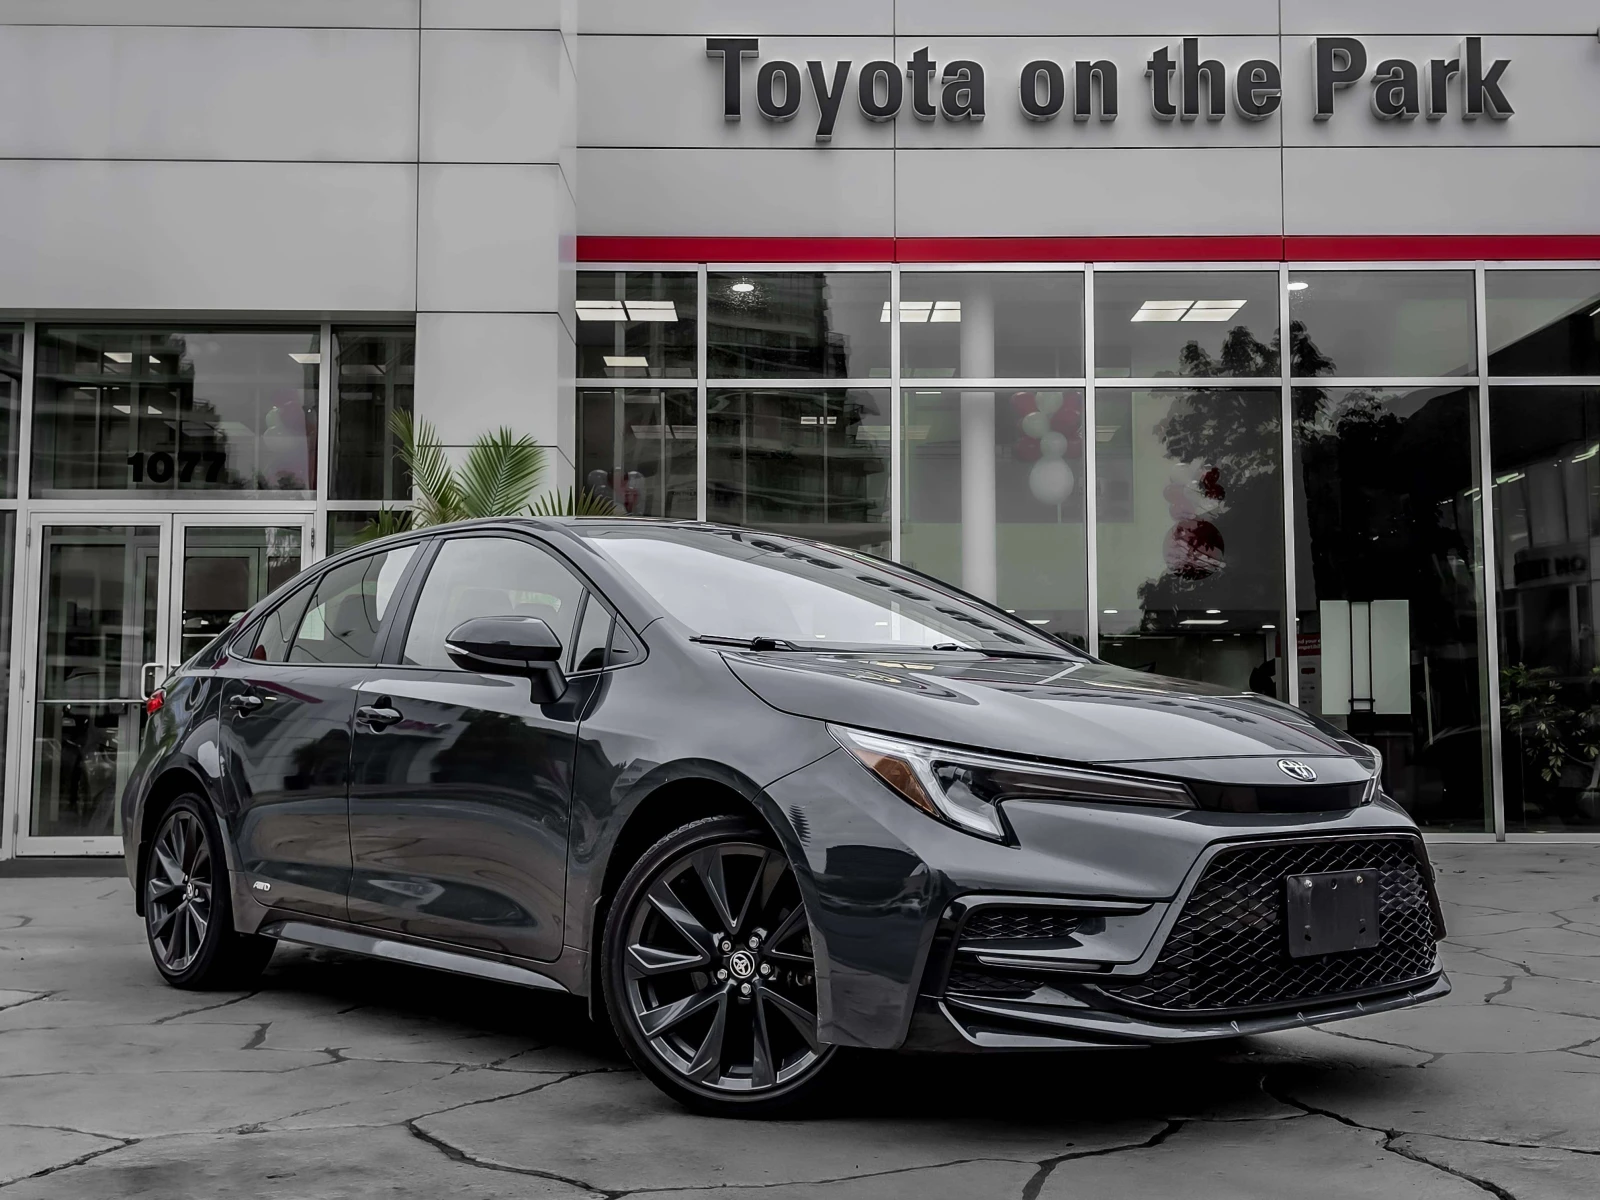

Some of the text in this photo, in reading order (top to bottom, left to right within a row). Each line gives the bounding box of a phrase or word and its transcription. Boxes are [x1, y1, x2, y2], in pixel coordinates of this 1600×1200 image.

[706, 37, 1516, 142] Toyota on the Park
[127, 451, 227, 483] 1077
